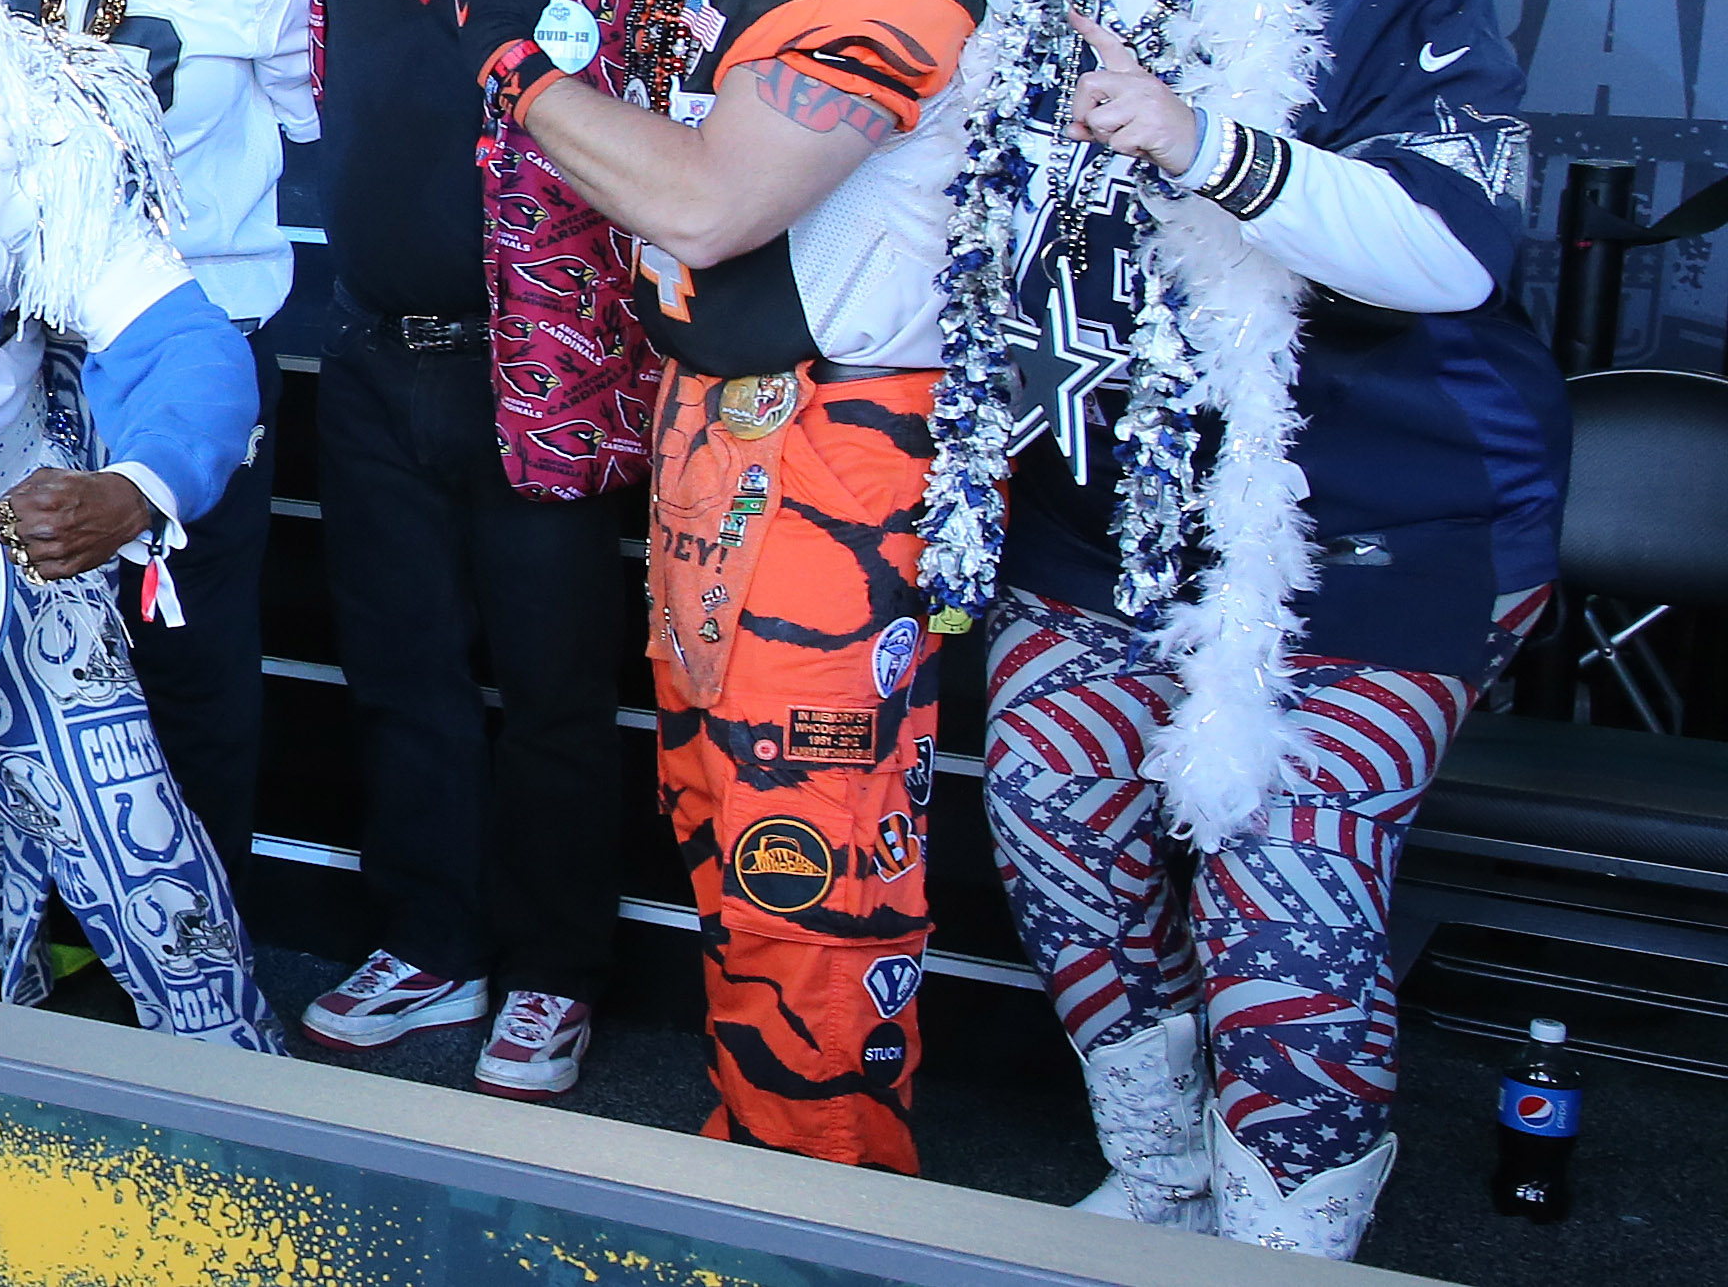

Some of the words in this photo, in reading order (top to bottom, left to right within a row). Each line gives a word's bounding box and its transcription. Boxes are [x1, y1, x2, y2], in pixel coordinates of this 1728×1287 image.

[537, 320, 604, 367] CARDINALS
[557, 322, 597, 351] ARIZONA
[864, 1046, 903, 1062] STUCK
